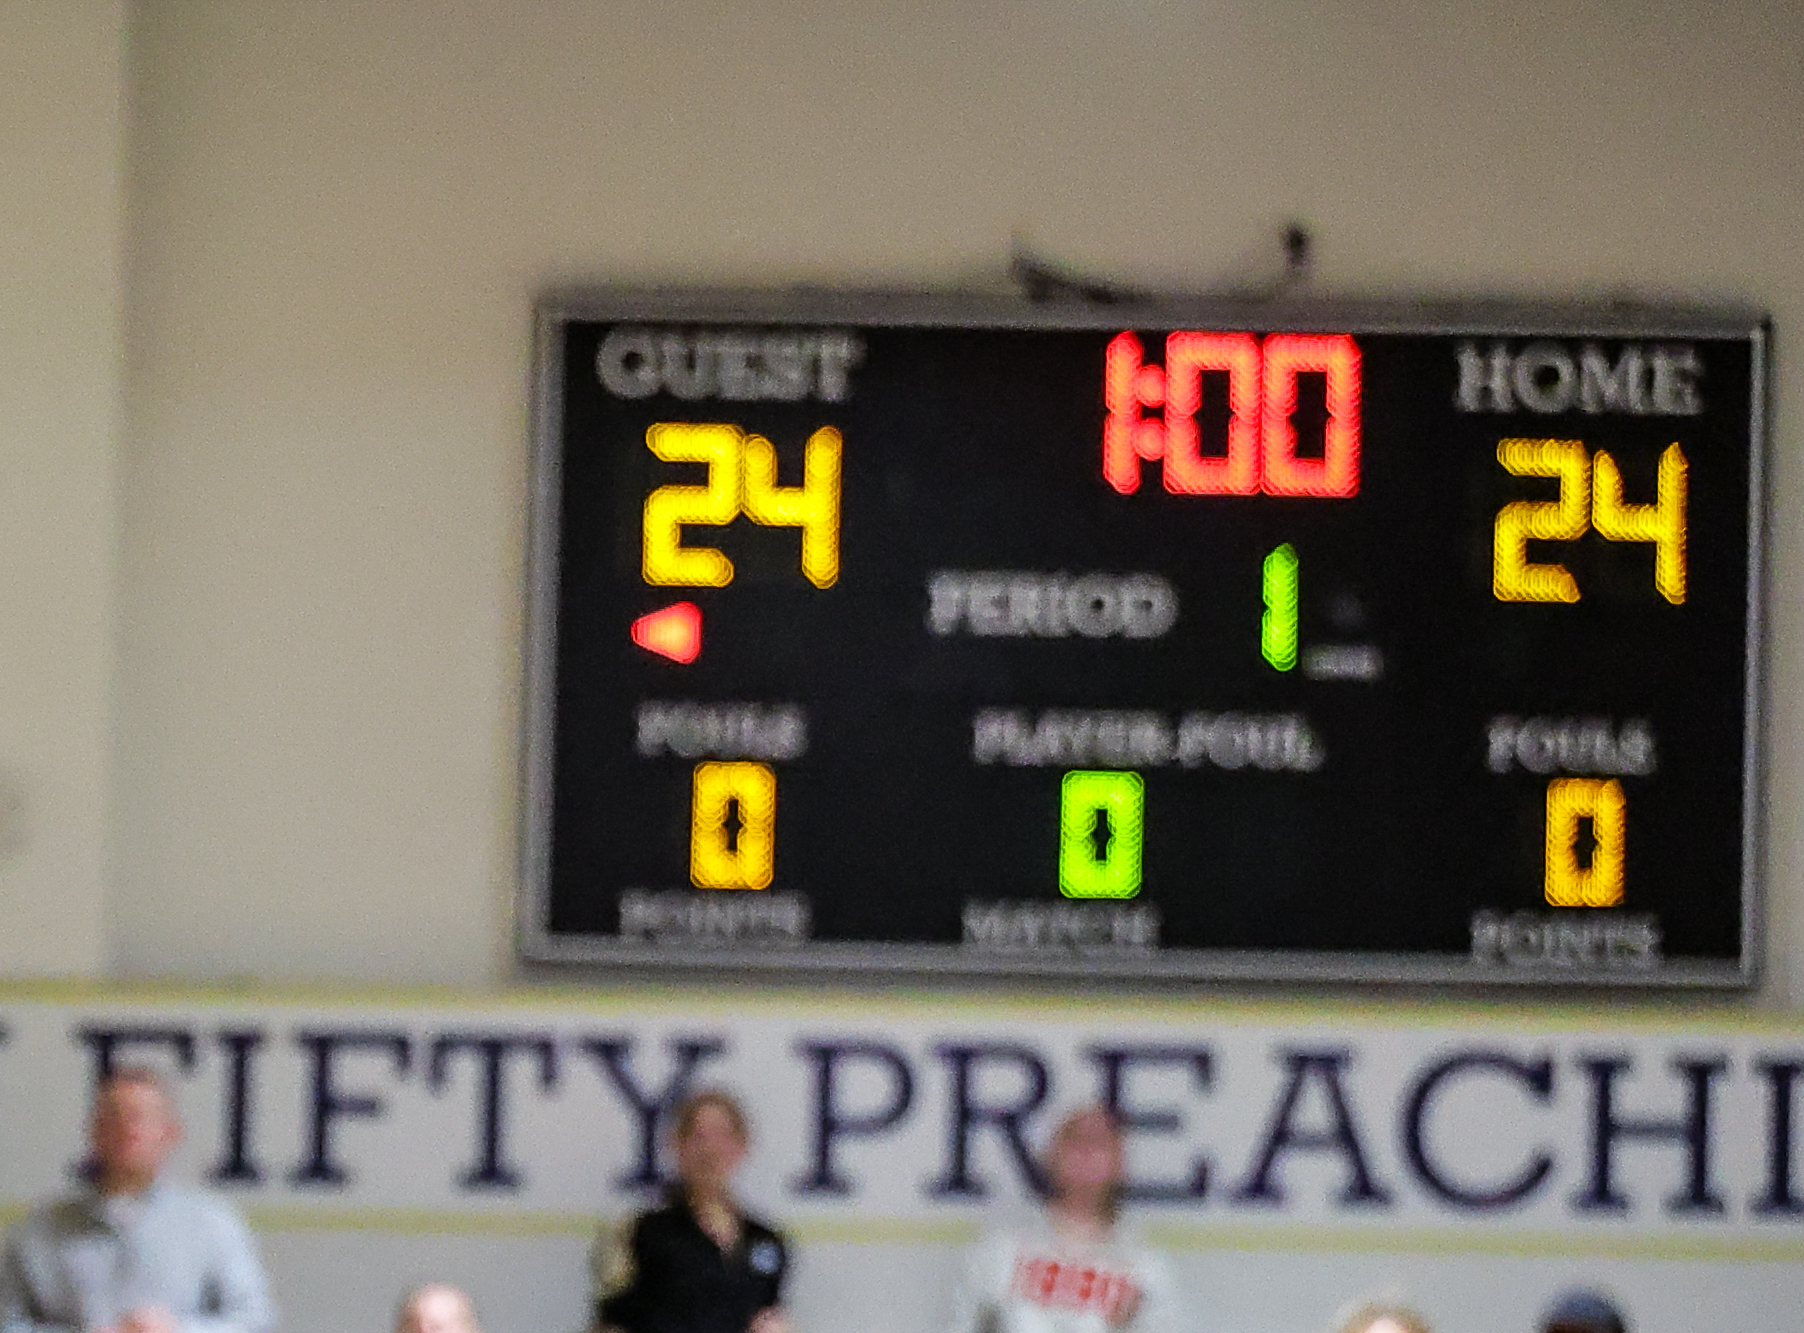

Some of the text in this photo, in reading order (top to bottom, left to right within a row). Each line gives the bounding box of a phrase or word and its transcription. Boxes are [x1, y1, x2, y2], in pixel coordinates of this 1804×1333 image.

[596, 328, 867, 402] GUEST
[1103, 330, 1363, 498] 1:00
[1454, 340, 1706, 416] HOME
[642, 422, 843, 590] 24
[1493, 438, 1689, 606] 24
[924, 567, 1180, 640] PERIOD
[1261, 542, 1299, 672] 1
[635, 698, 809, 760] FOULS
[1486, 713, 1658, 776] FOULS
[690, 760, 778, 890] 0
[1058, 770, 1145, 899] 0
[1545, 777, 1627, 908] 0
